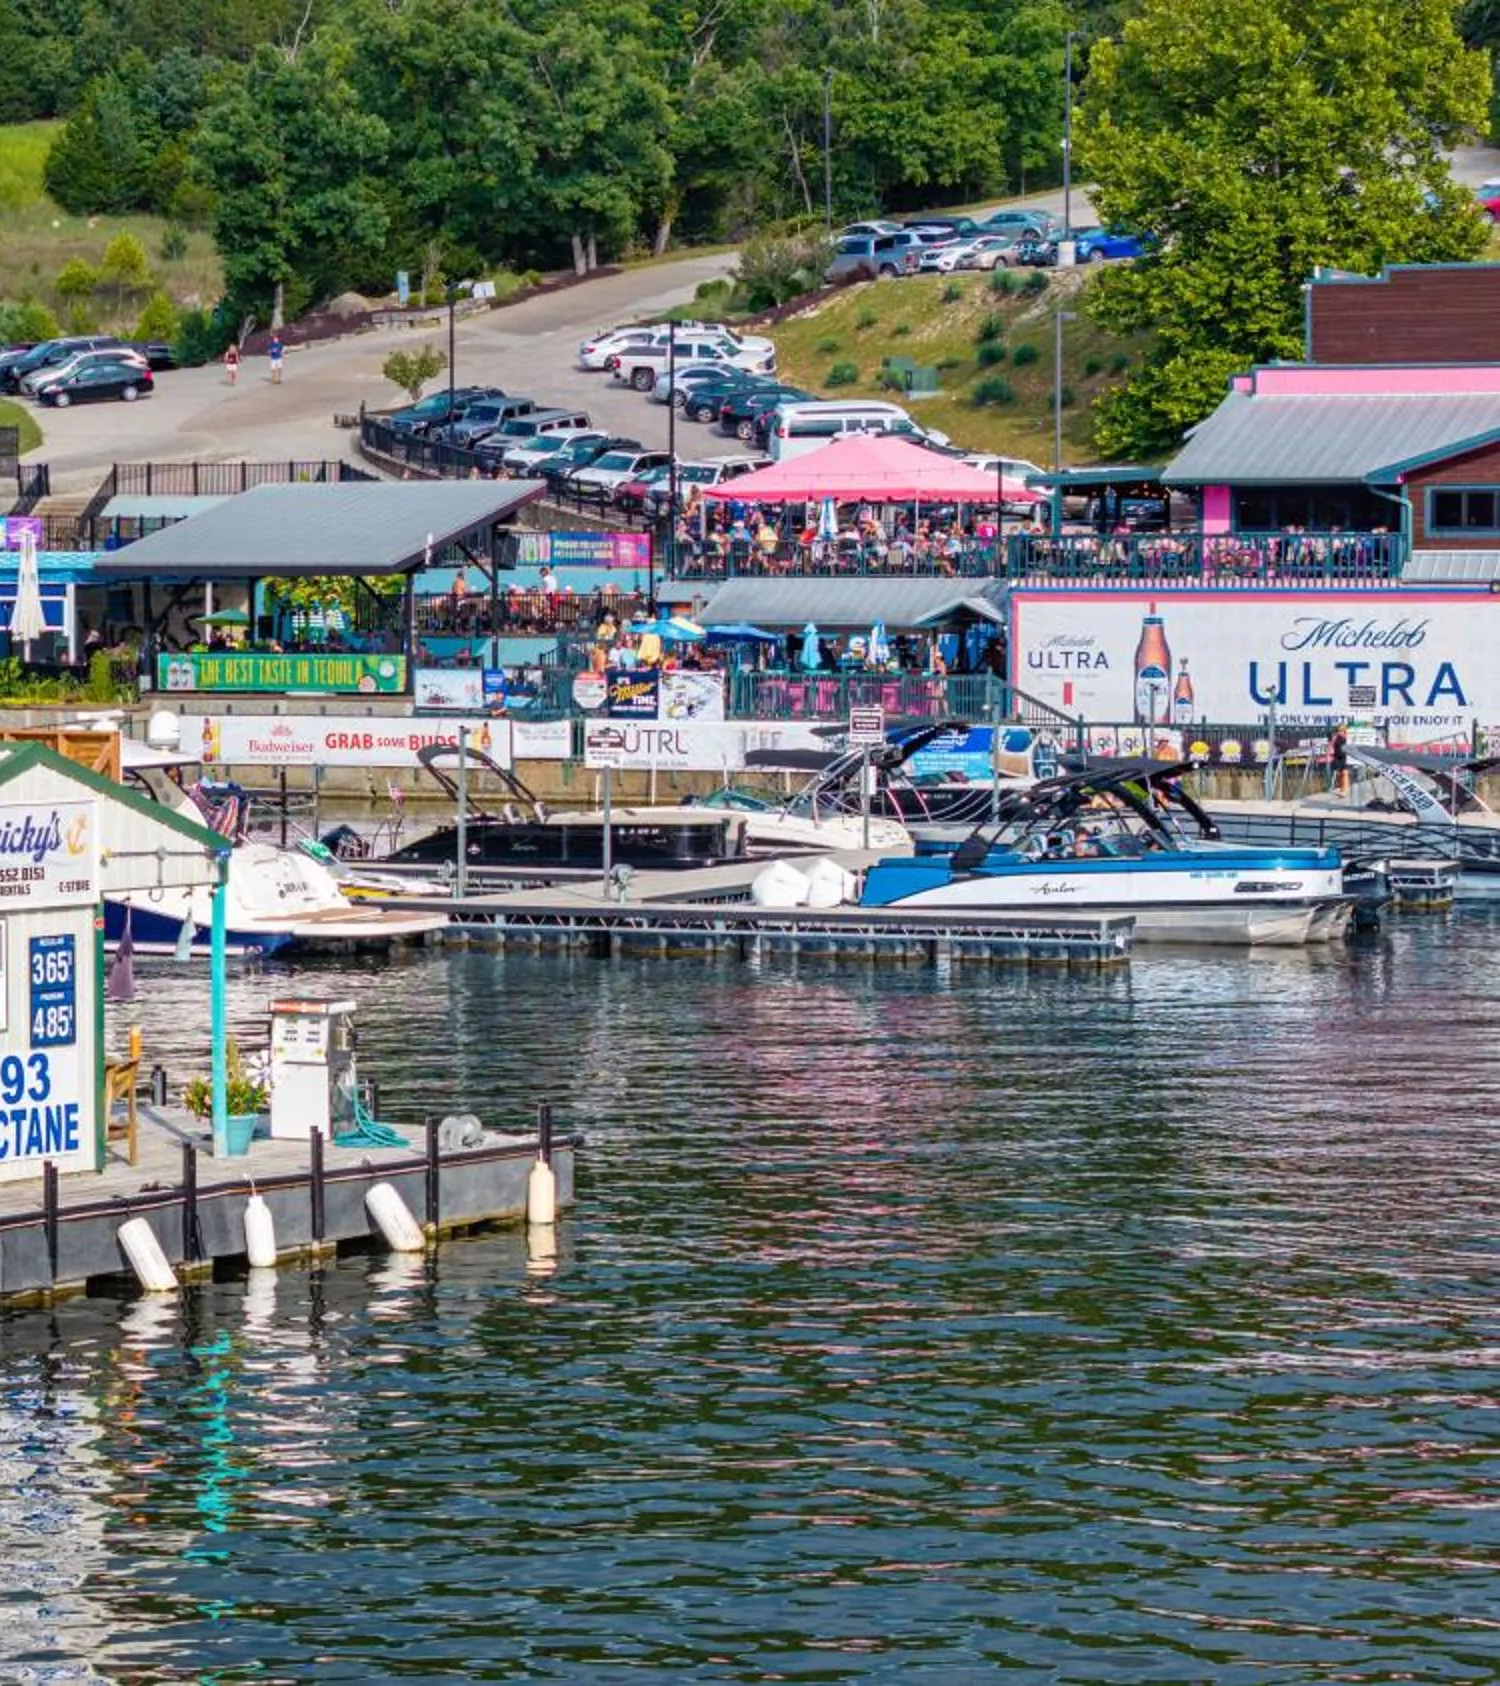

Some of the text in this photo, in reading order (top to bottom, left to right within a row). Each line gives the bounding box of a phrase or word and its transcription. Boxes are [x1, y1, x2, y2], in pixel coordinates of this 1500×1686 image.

[1281, 617, 1433, 651] Michelob
[200, 659, 220, 684] THE
[225, 659, 253, 685] BEST
[259, 659, 292, 685] TASTE
[313, 659, 363, 686] TEQUILA
[1027, 651, 1110, 669] ULTRA
[1249, 661, 1467, 706] ULTRA
[1280, 714, 1309, 726] ONLY
[1412, 714, 1449, 726] ENJOY
[1452, 714, 1464, 726] IT
[249, 739, 314, 753] Budweiser
[324, 733, 457, 751] GRAB SOME BUDS
[608, 722, 688, 755] ÜTRL
[0, 1053, 51, 1105] 93
